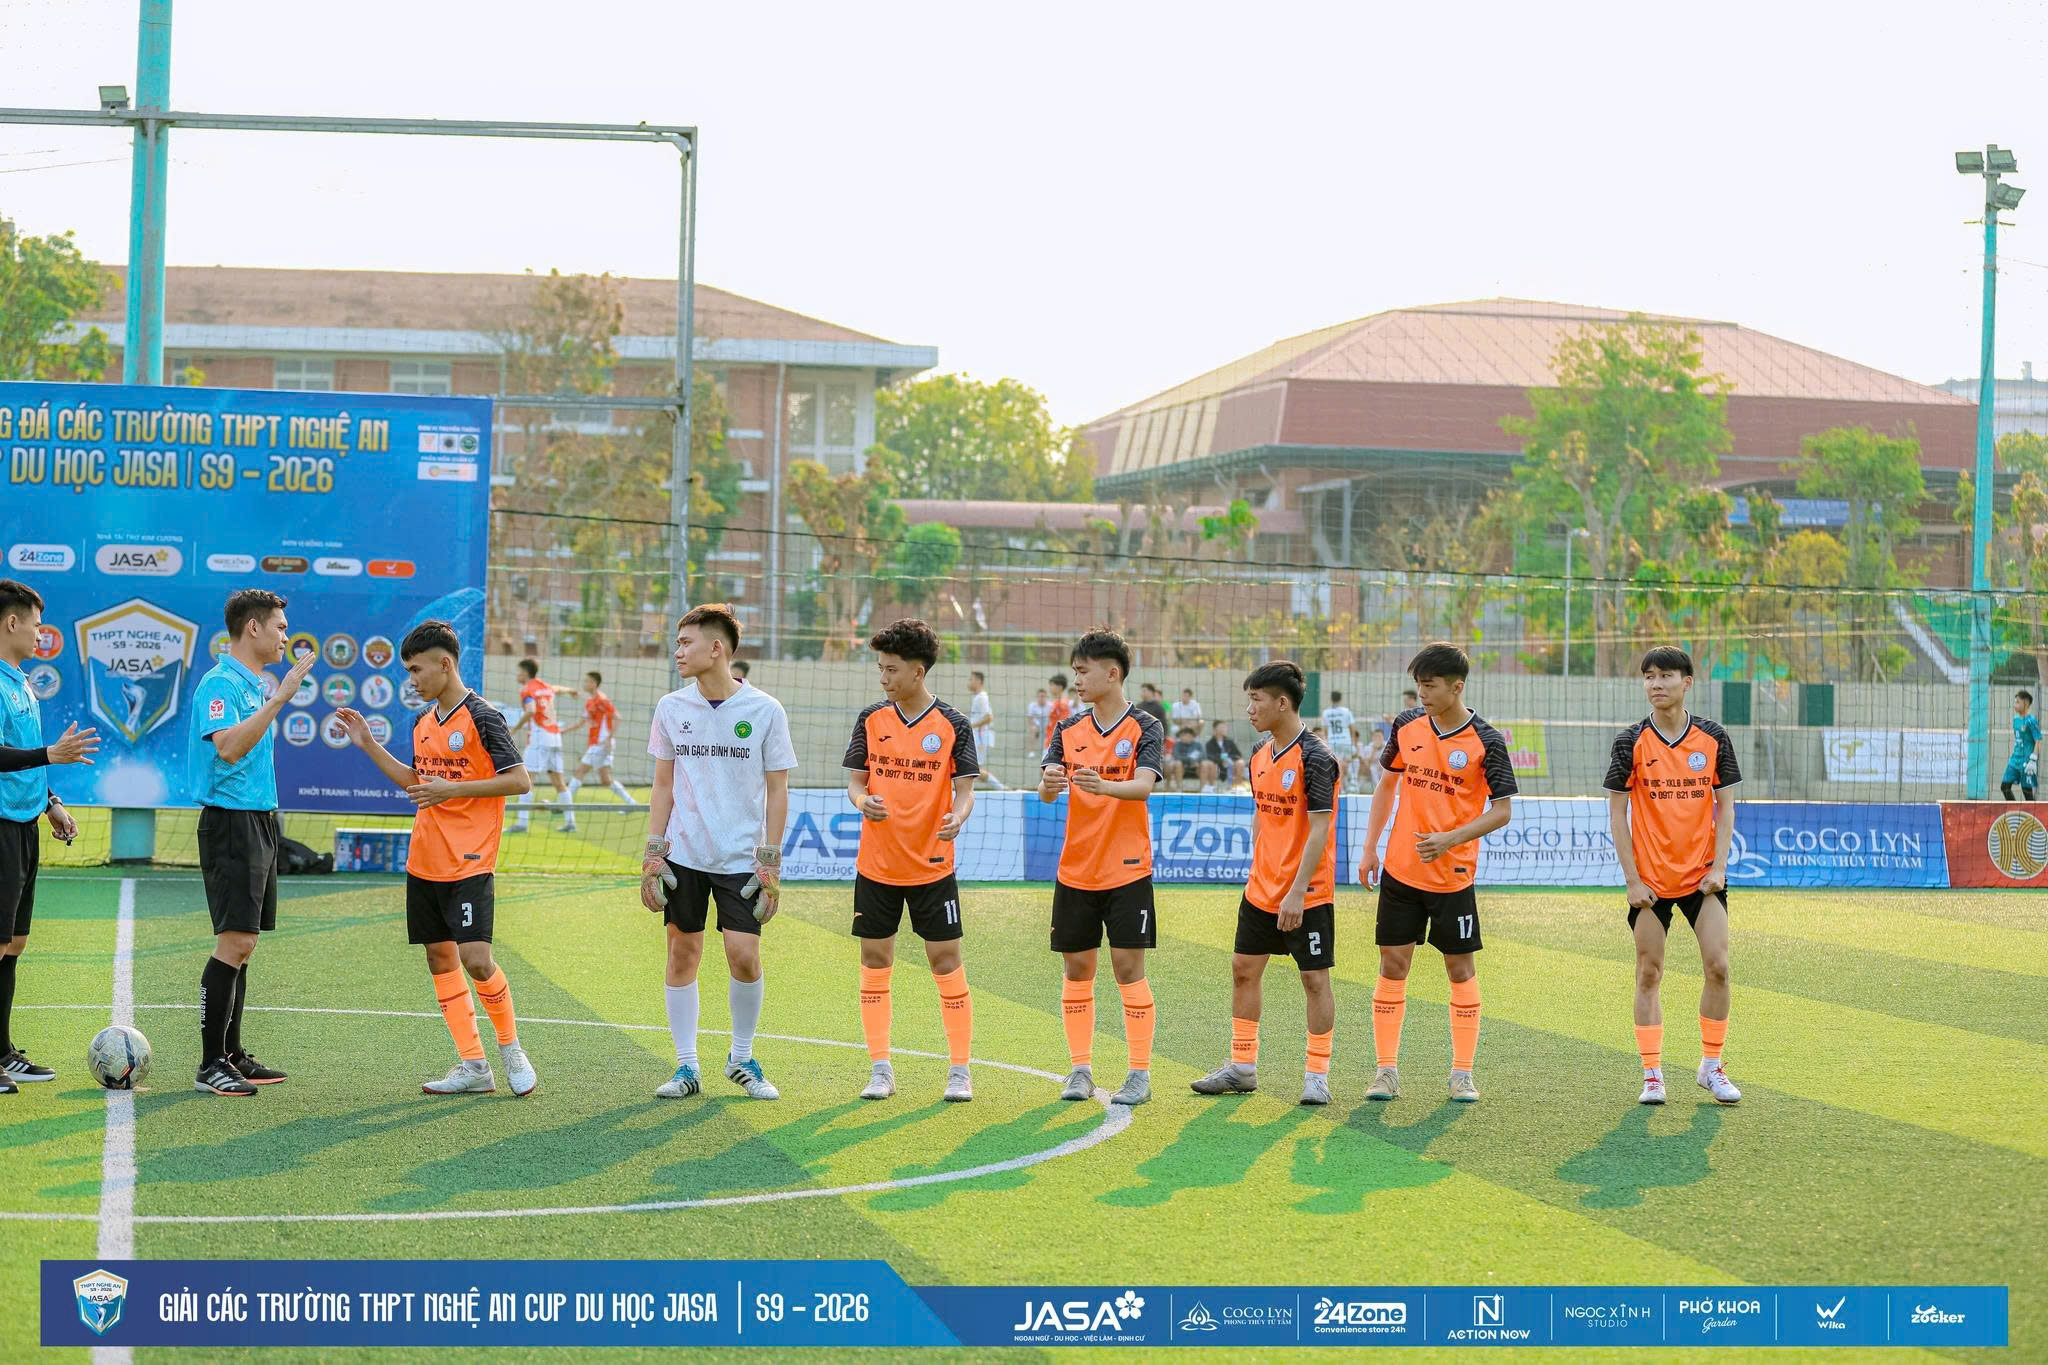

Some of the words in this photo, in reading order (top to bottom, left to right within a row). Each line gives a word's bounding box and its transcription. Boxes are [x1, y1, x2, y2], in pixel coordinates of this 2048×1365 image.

[18, 402, 49, 440] ĐÁ
[57, 402, 103, 441] CÁC
[112, 404, 213, 446] TRƯỜNG
[220, 413, 282, 448] THPT
[289, 411, 351, 457] NGHỆ
[357, 419, 389, 451] AN
[11, 447, 45, 483] DU
[54, 448, 105, 493] HỌC
[113, 450, 178, 488] JASA
[200, 452, 235, 489] S9
[268, 455, 334, 492] 2026
[110, 552, 158, 567] JASA
[91, 630, 125, 642] THPT
[127, 630, 161, 641] NGHE
[163, 633, 182, 644] AN
[136, 641, 161, 650] 2026
[106, 658, 154, 672] JASA
[676, 744, 690, 756] SƠN
[692, 745, 710, 759] GẠCH
[711, 743, 729, 758] BÌNH
[730, 747, 751, 761] NGỌC
[903, 771, 916, 781] 621
[918, 773, 933, 783] 989
[1430, 781, 1443, 793] 621
[1676, 791, 1688, 799] 621
[1691, 789, 1705, 799] 989
[782, 811, 862, 858] AS
[1168, 819, 1251, 854] Zon
[1486, 851, 1529, 861] PHONG
[1779, 854, 1828, 867] PHONG
[1831, 852, 1866, 868] THỦY
[1891, 854, 1922, 869] TÂM
[462, 902, 473, 927] 3
[944, 900, 958, 925] 11
[1140, 909, 1148, 934] 7
[1457, 914, 1473, 939] 17
[1308, 931, 1322, 956] 2
